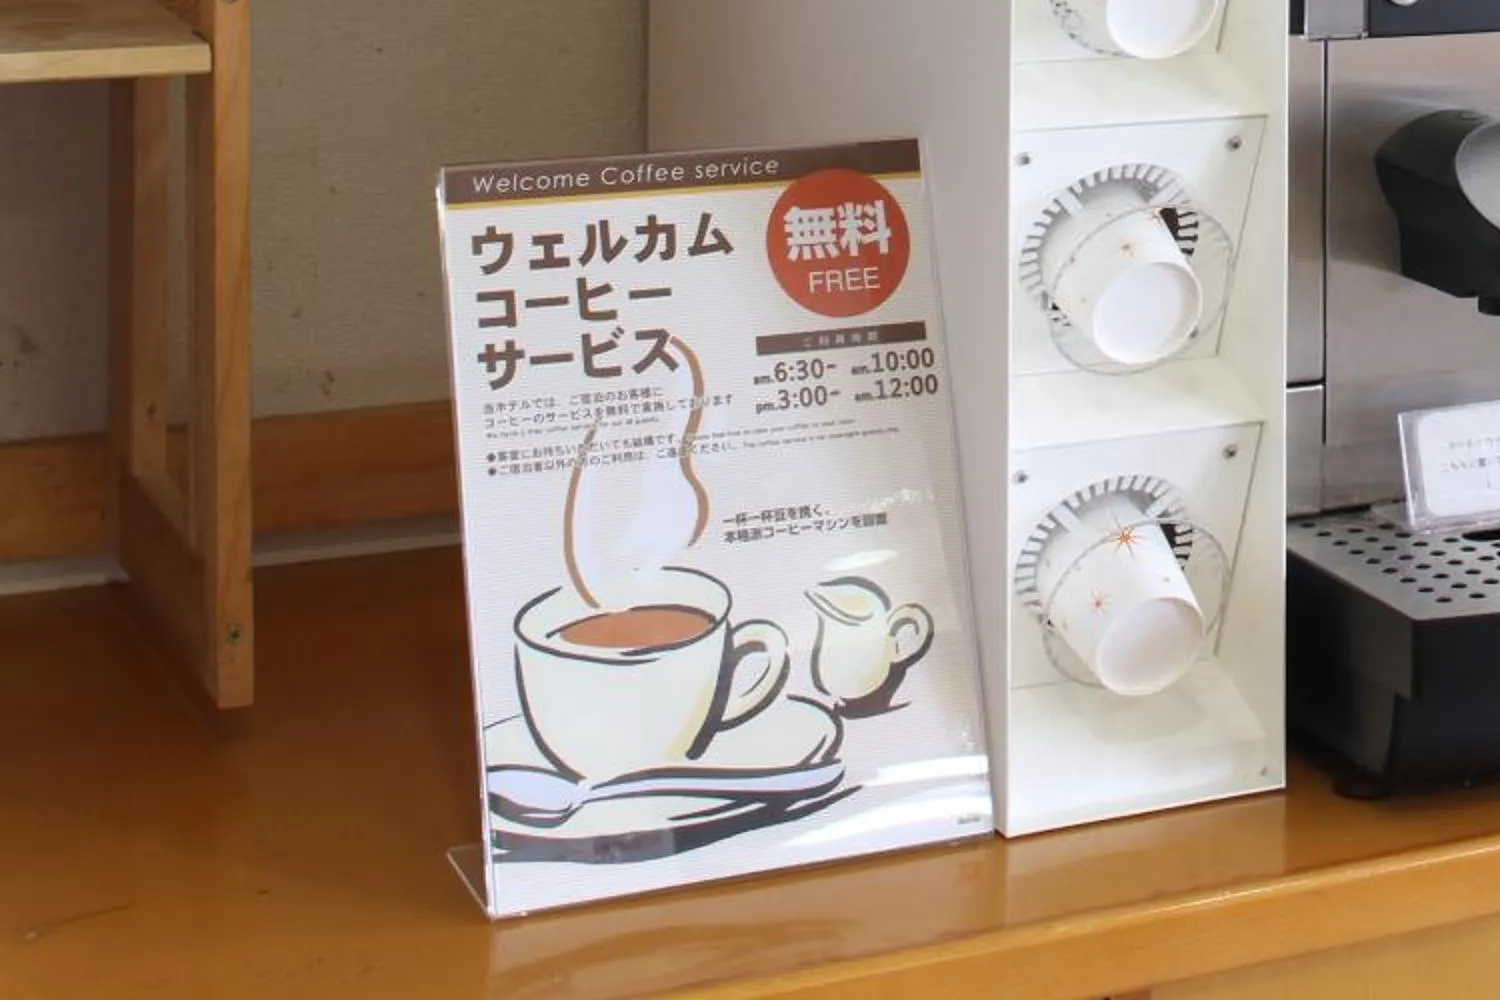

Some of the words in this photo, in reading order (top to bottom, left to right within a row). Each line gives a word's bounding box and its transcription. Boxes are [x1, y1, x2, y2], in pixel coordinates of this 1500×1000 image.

[473, 171, 590, 194] Welcome
[601, 163, 685, 186] Coffee
[694, 157, 779, 179] service
[471, 212, 735, 275] ウェルカム
[784, 199, 891, 262] 無料
[476, 277, 672, 329] コーヒー
[809, 267, 881, 293] FREE
[477, 327, 680, 391] サービス
